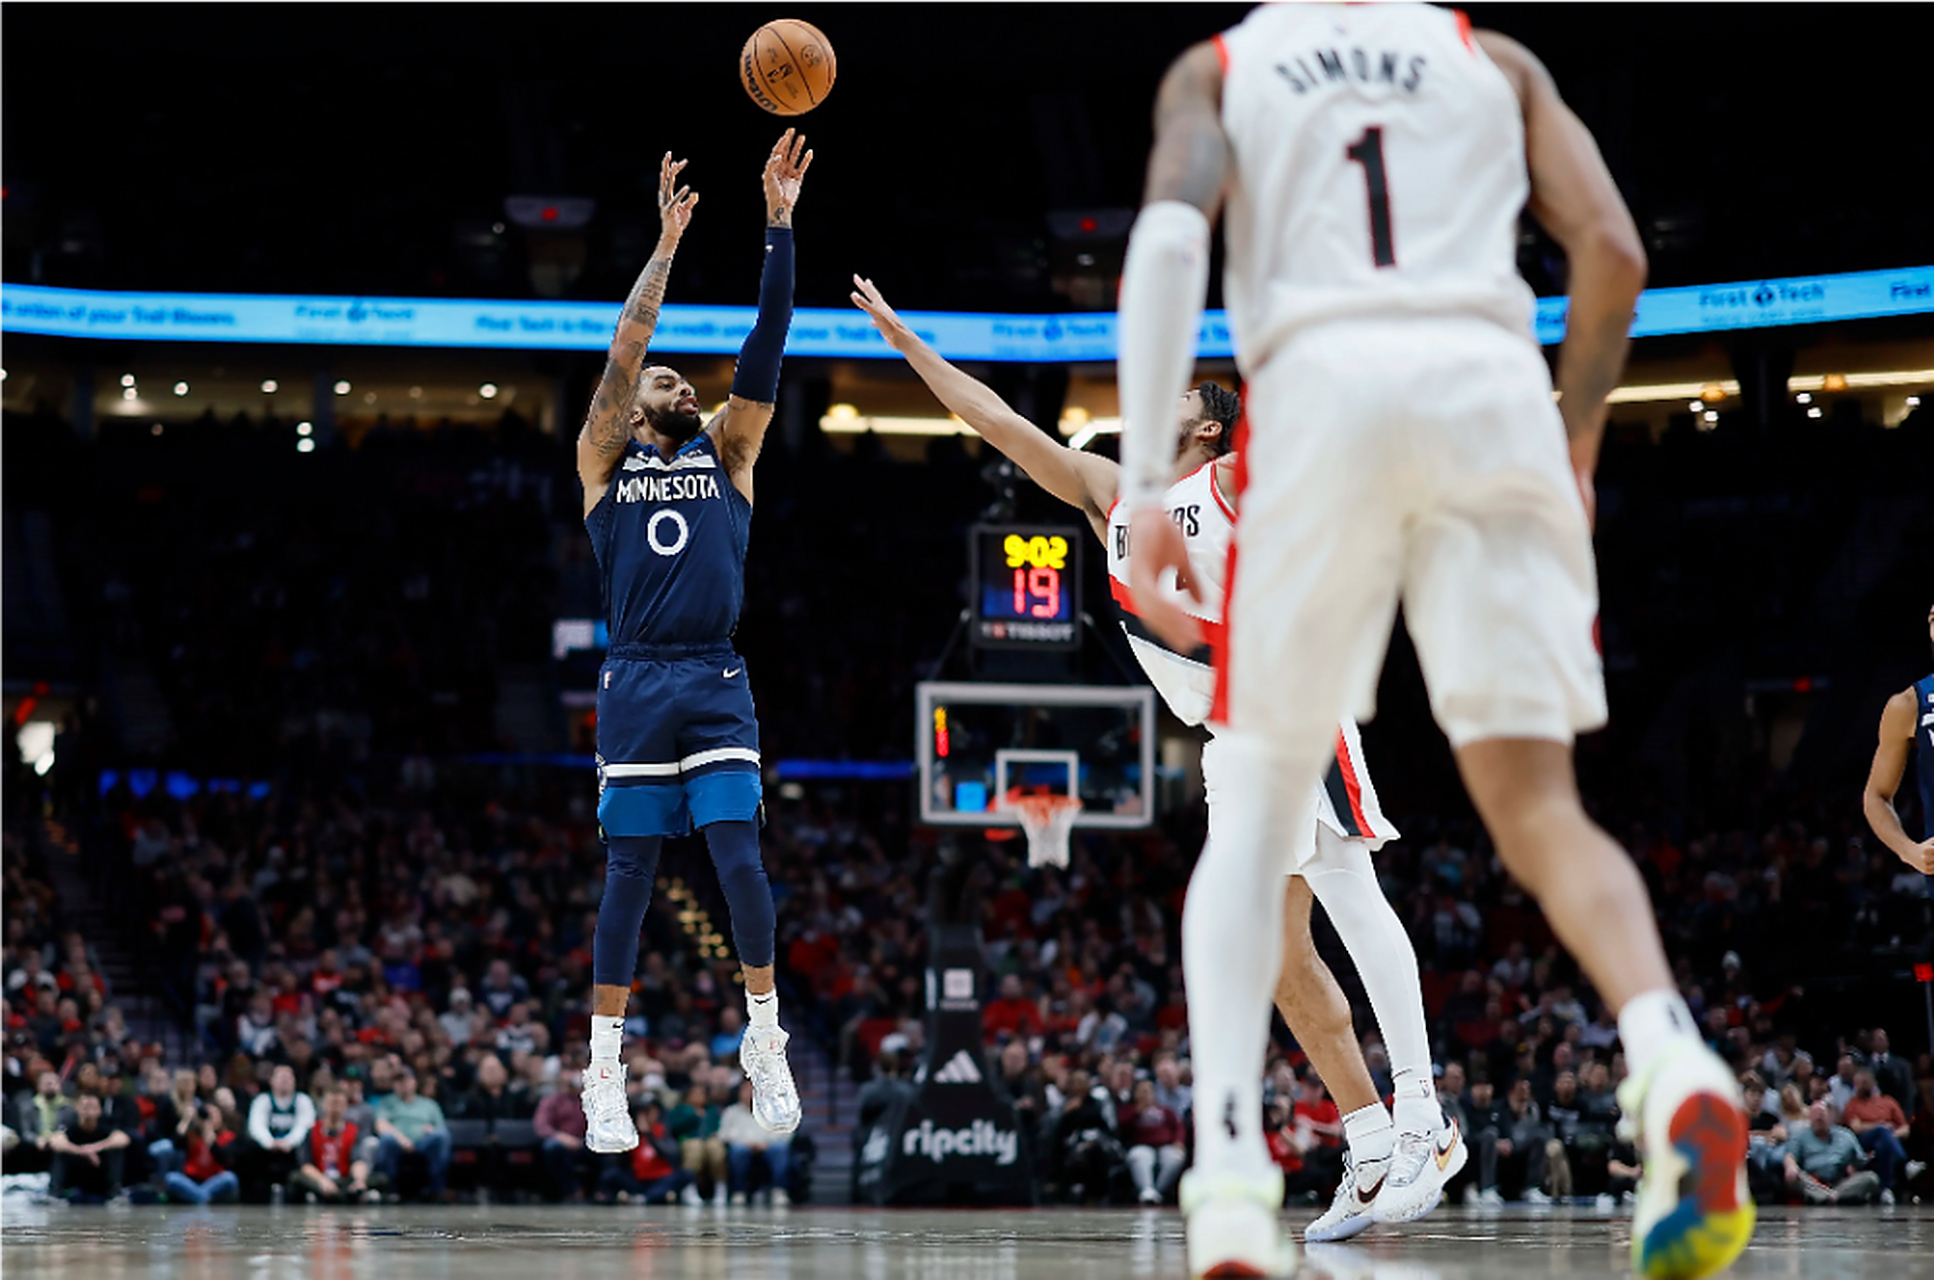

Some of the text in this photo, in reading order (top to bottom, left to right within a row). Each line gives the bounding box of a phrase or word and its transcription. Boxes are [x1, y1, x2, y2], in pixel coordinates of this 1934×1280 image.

[1274, 46, 1427, 94] SIMONS
[1344, 123, 1396, 269] 1
[616, 474, 721, 503] MINNESOTA
[647, 508, 689, 556] 0
[1004, 534, 1068, 569] 9:02
[1014, 566, 1060, 618] 19
[903, 1118, 1018, 1165] ripcity
